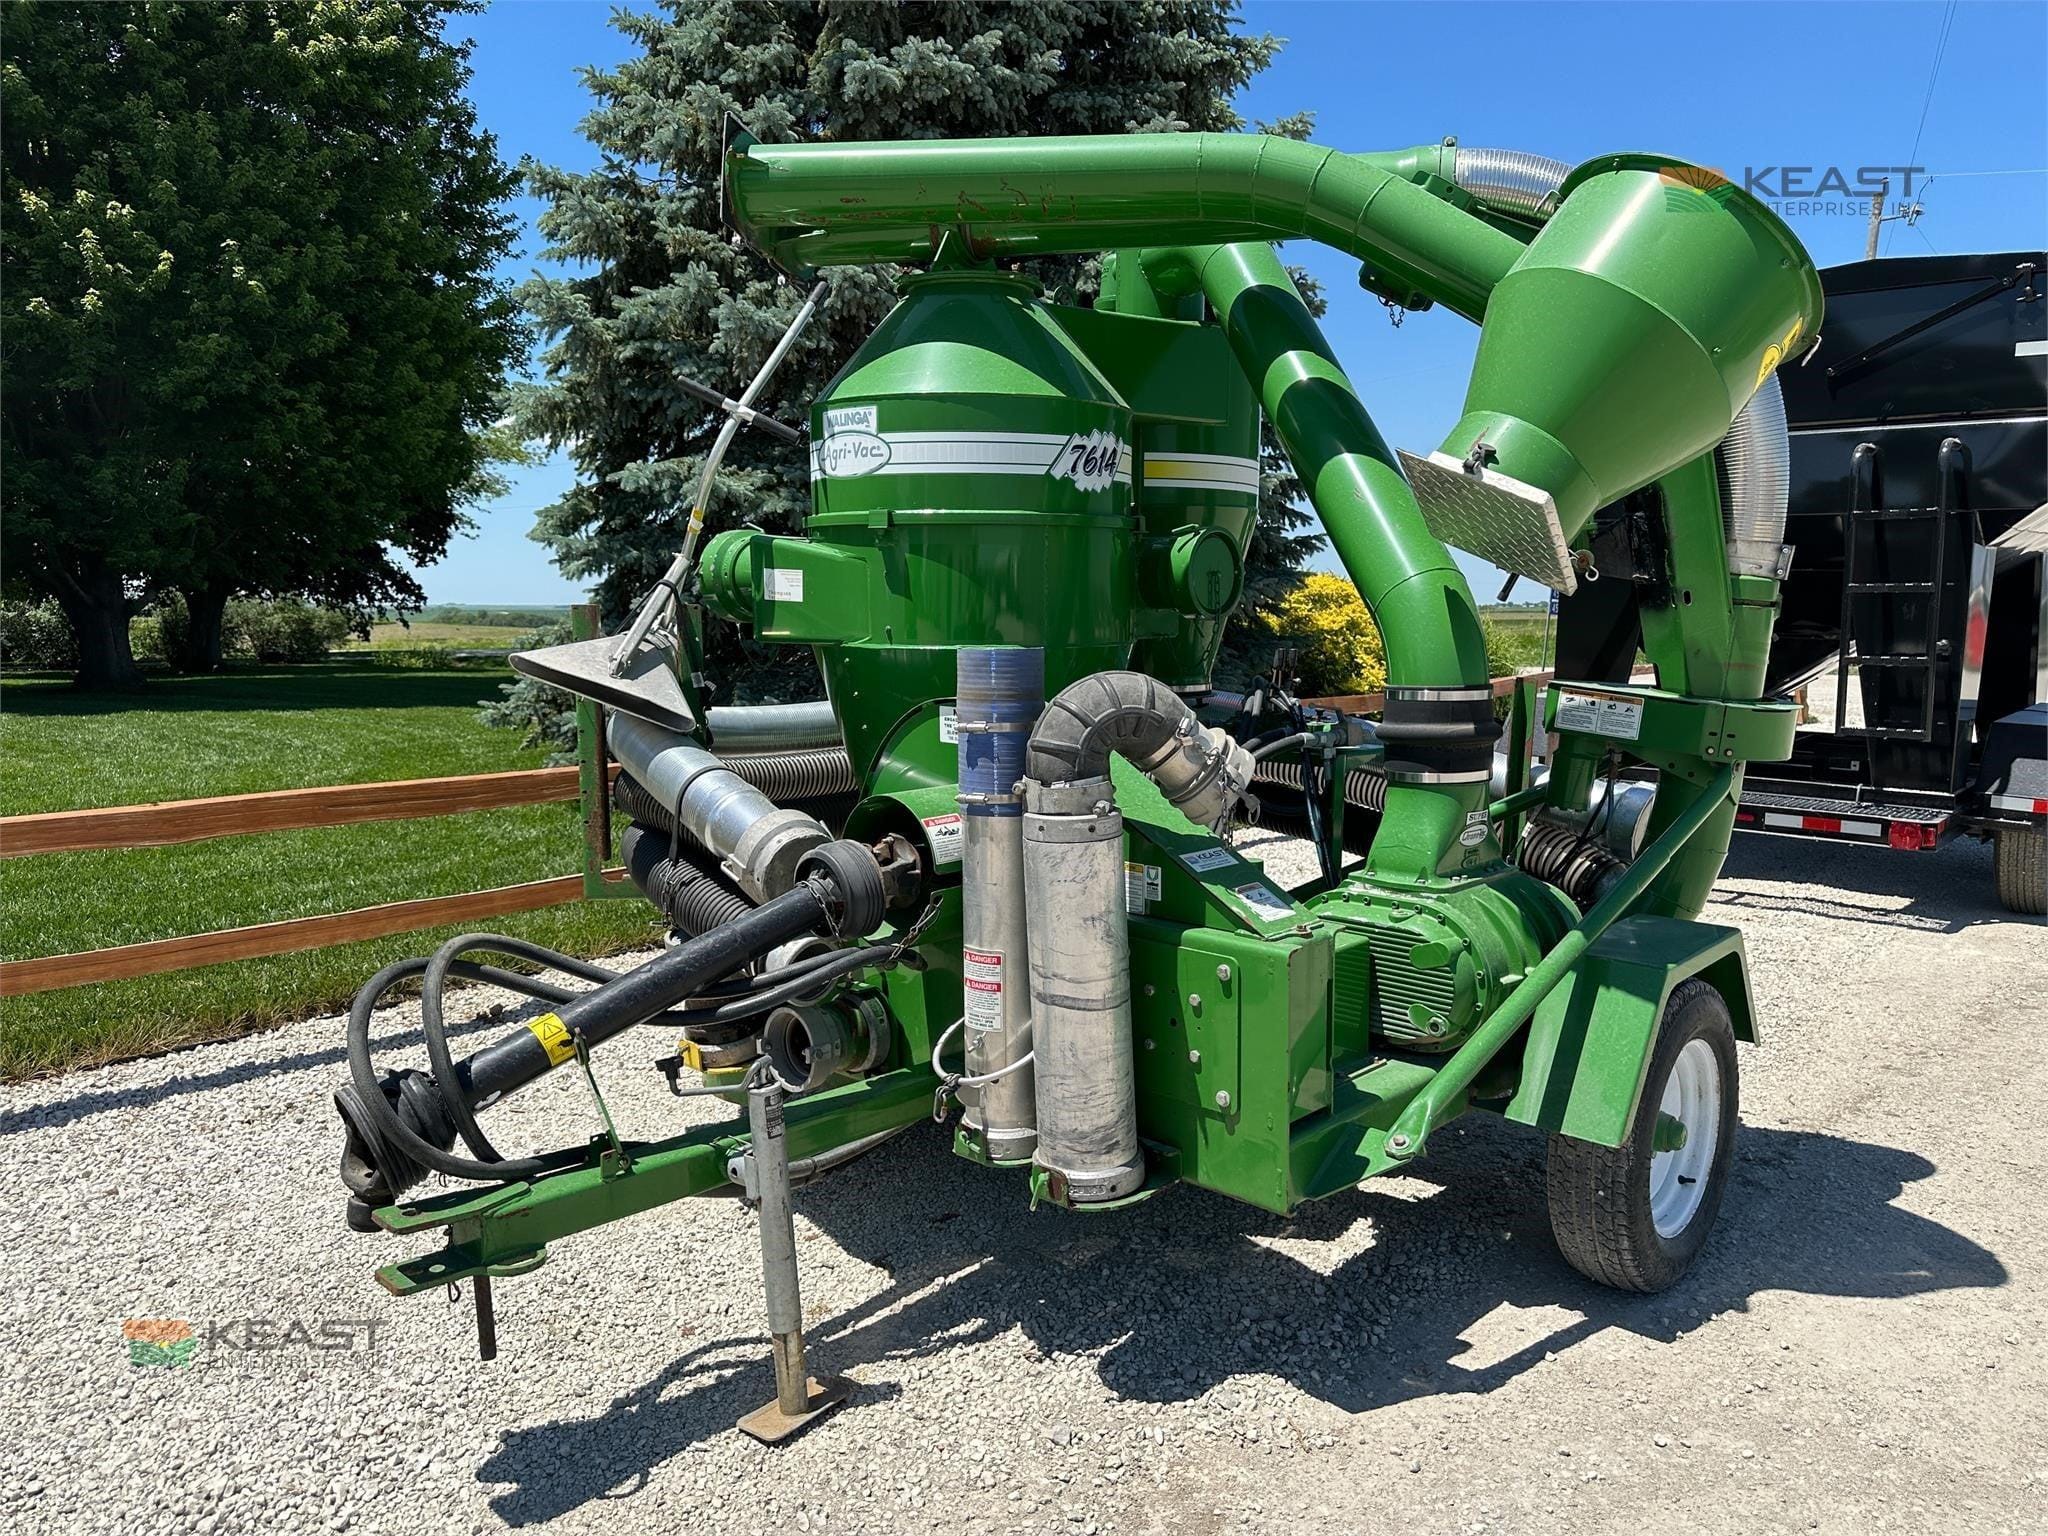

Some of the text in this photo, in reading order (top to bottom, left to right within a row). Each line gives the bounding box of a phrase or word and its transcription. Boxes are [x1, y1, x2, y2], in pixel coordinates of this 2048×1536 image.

[822, 441, 883, 471] Agri-Vac
[1070, 444, 1118, 477] 7614
[1196, 849, 1226, 860] KEAST
[970, 954, 998, 964] DANGER
[971, 981, 998, 991] DANGER
